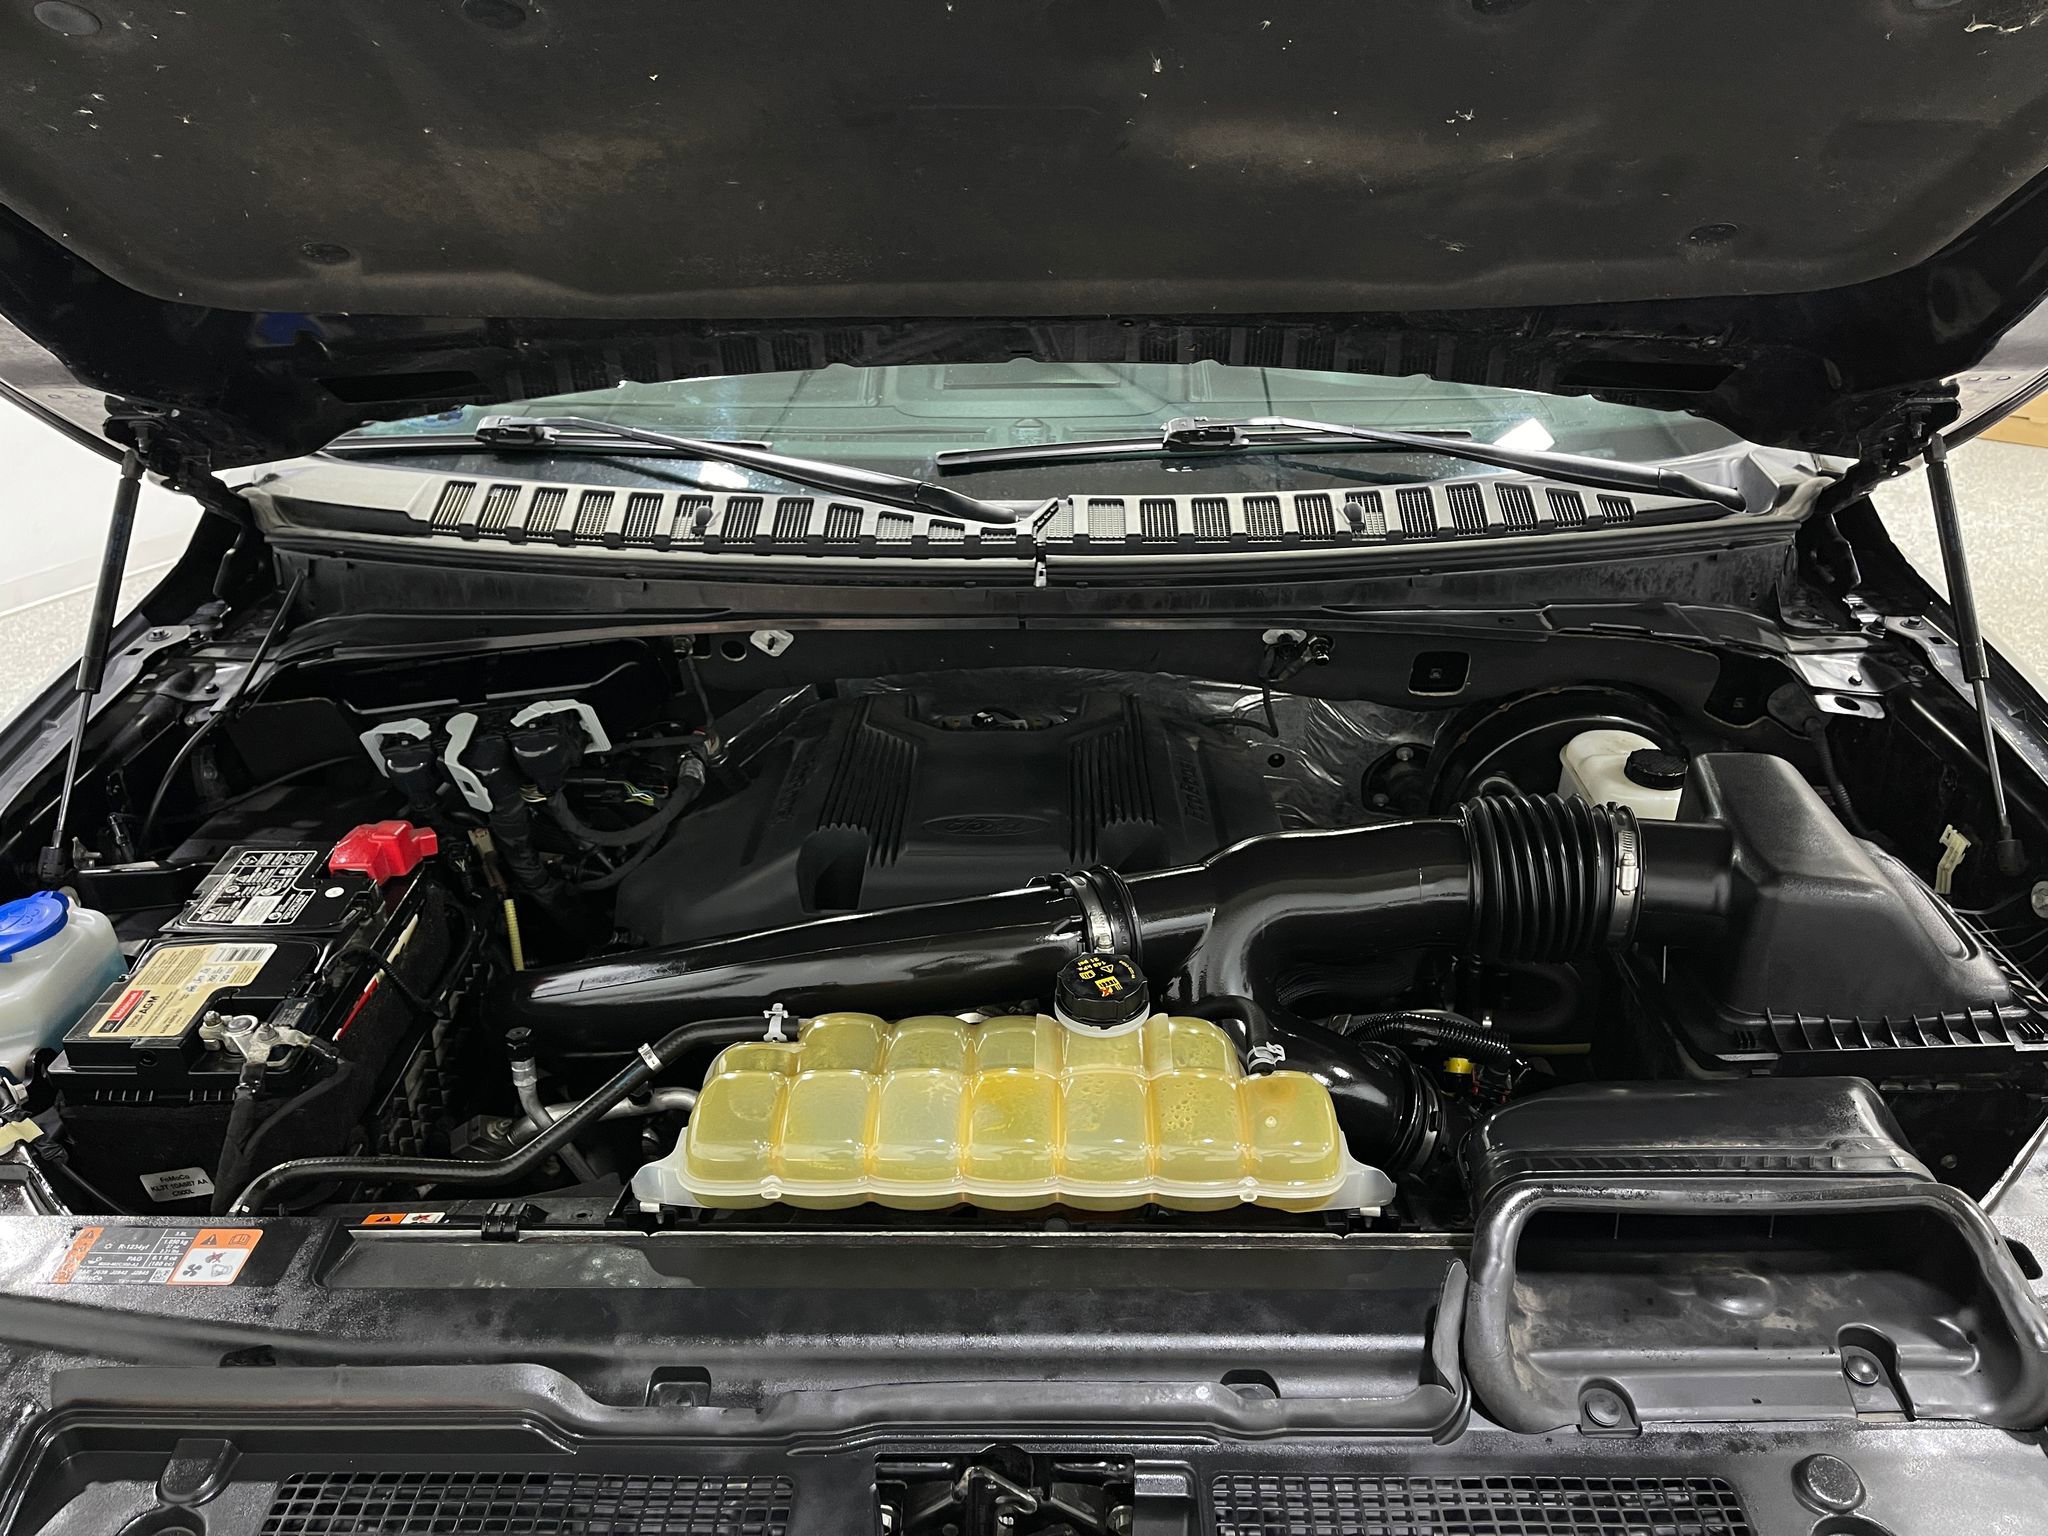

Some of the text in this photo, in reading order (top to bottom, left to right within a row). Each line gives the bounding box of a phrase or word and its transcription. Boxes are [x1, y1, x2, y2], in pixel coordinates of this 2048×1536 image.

[945, 816, 1025, 833] Ford
[138, 995, 161, 1016] AGM
[160, 1174, 190, 1183] FoMoCo
